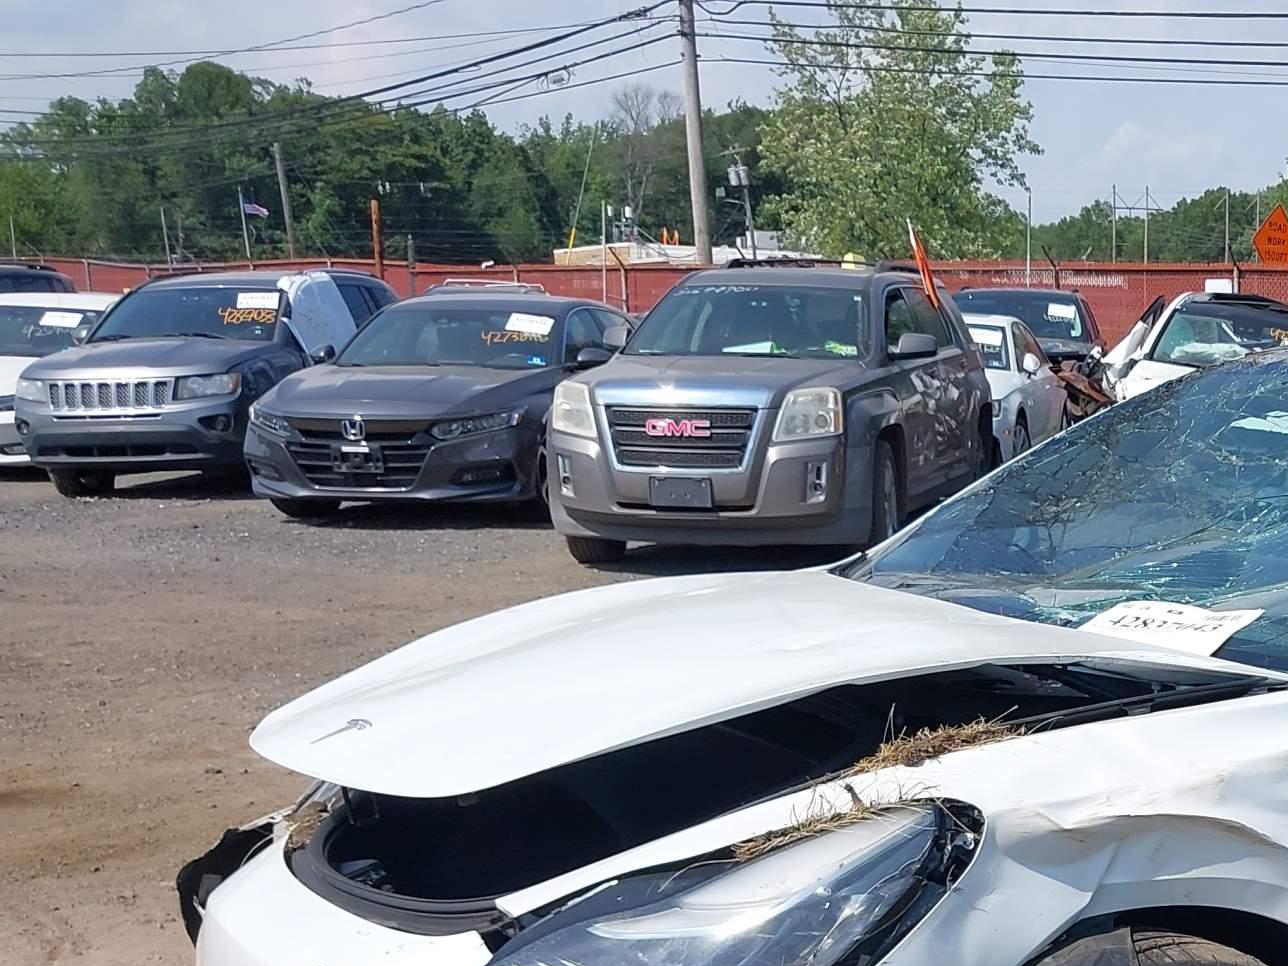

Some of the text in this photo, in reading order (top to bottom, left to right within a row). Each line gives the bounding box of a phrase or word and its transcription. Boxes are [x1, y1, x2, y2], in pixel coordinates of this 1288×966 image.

[1268, 221, 1287, 234] ROAD
[1267, 236, 1286, 246] WORK
[645, 418, 711, 437] GMC
[1109, 615, 1223, 633] 42837043
